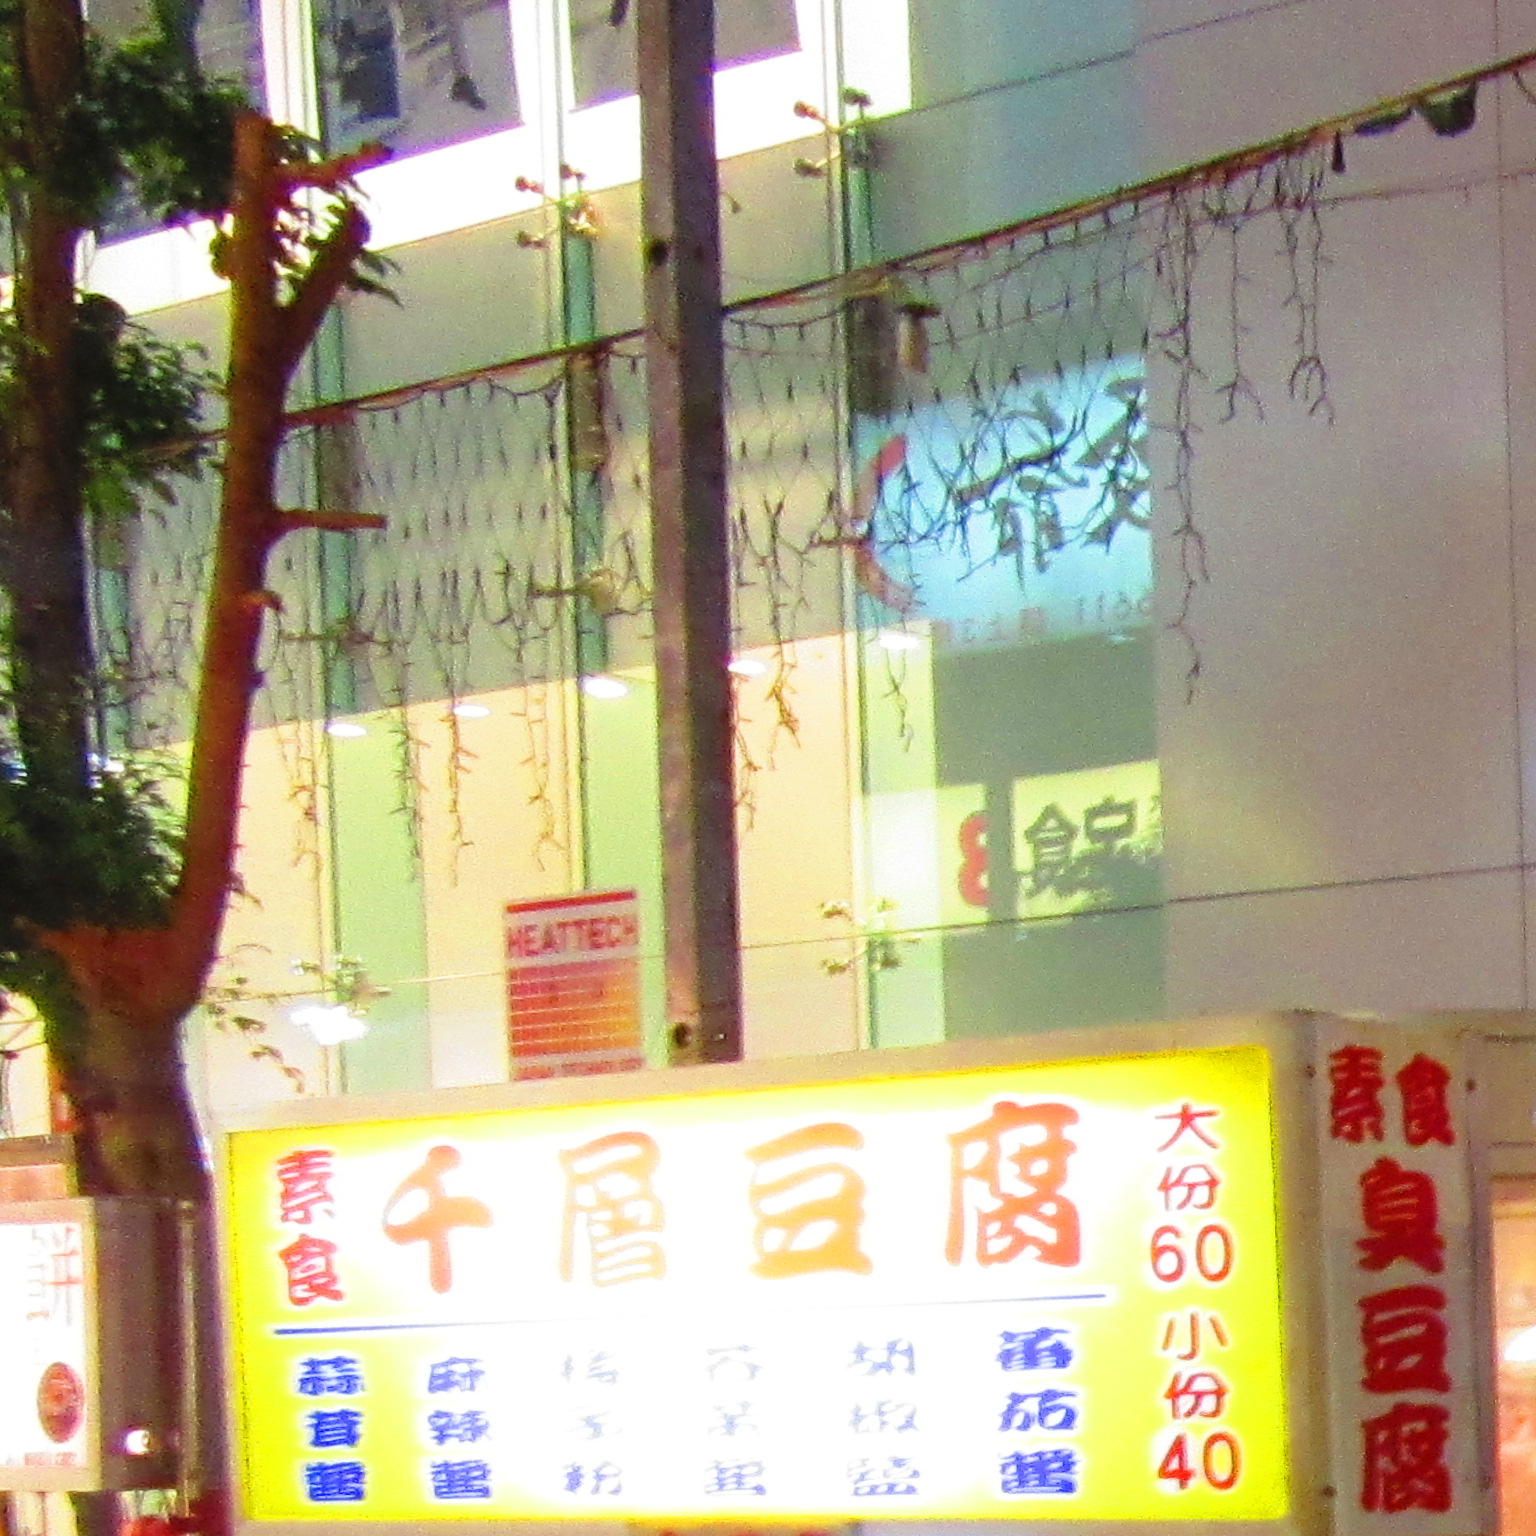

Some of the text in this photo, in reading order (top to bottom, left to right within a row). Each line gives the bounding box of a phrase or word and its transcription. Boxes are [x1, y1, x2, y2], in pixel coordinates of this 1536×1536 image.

[1329, 1045, 1455, 1146] 素食
[277, 1150, 346, 1306] 素食
[381, 1100, 1082, 1294] 千層豆腐
[1355, 1157, 1452, 1513] 臭豆腐
